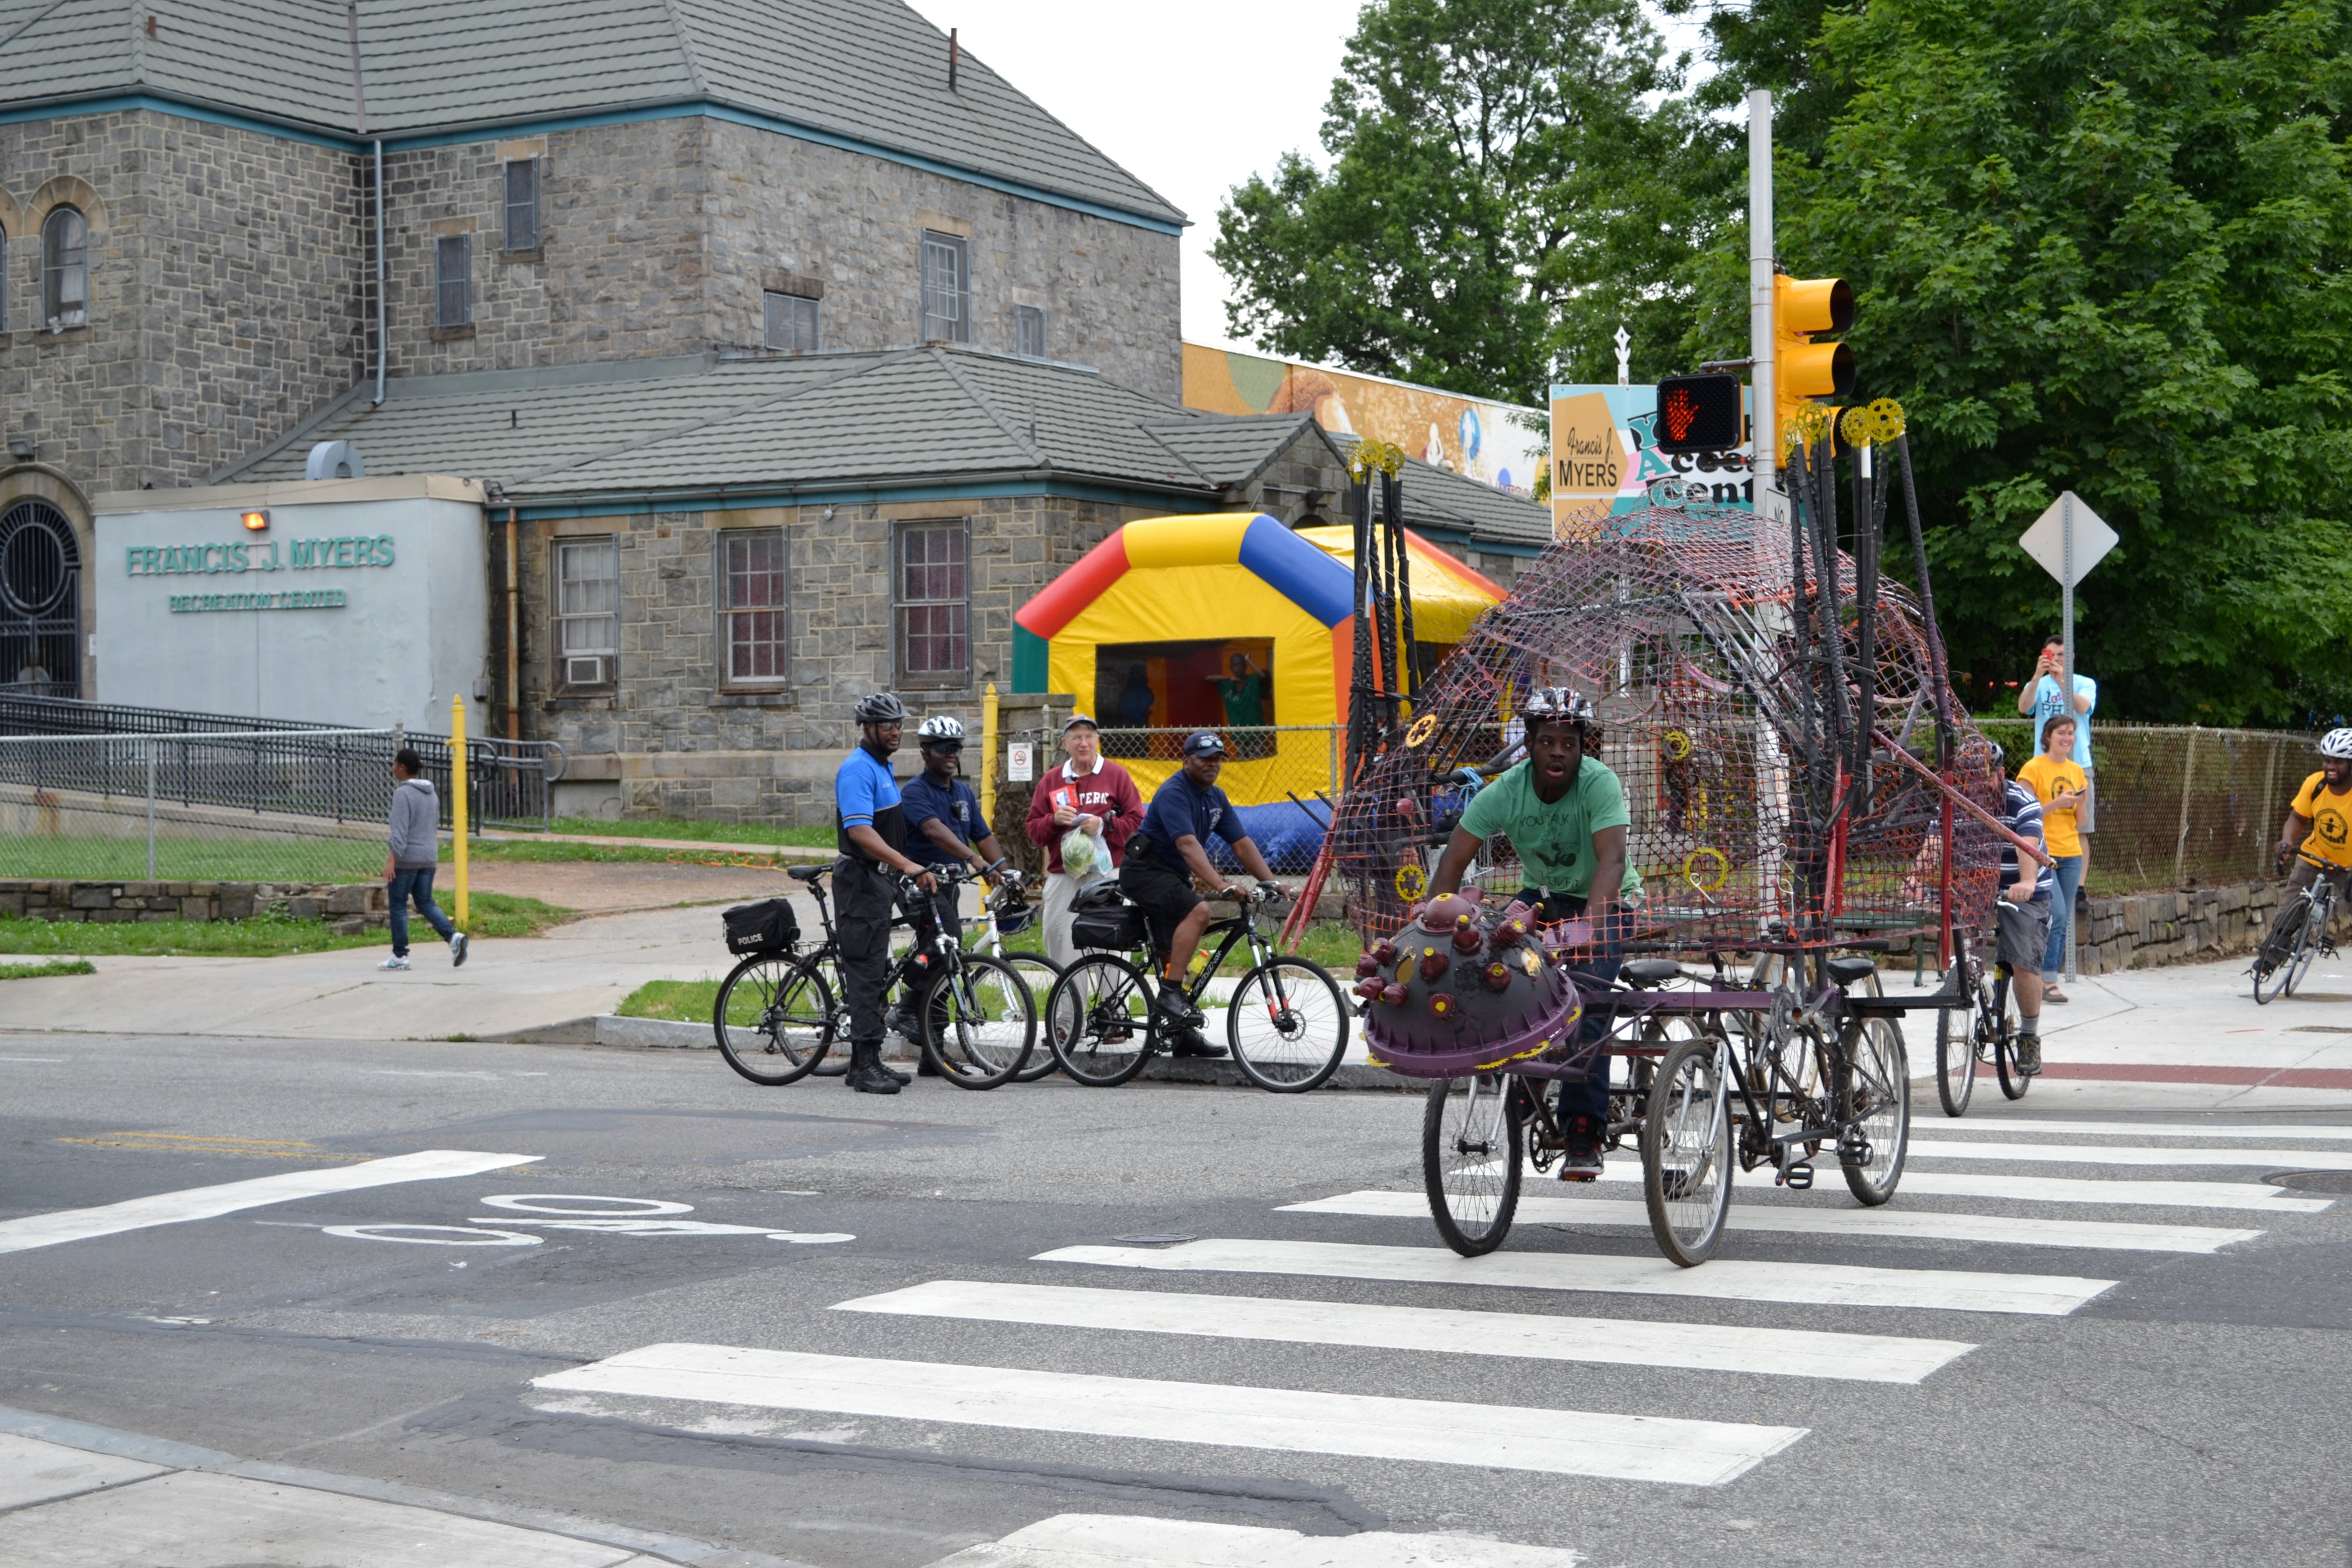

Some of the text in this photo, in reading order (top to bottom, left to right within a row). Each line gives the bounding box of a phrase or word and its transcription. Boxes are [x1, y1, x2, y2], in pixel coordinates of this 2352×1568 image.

[1567, 427, 1602, 455] Francis
[1605, 427, 1613, 464] J.
[1559, 460, 1617, 487] MYERS
[127, 534, 395, 574] FRANCIS J. MYERS
[169, 589, 346, 611] RECREATION CENTER
[1520, 815, 1544, 827] YOU
[738, 933, 764, 946] POLICE
